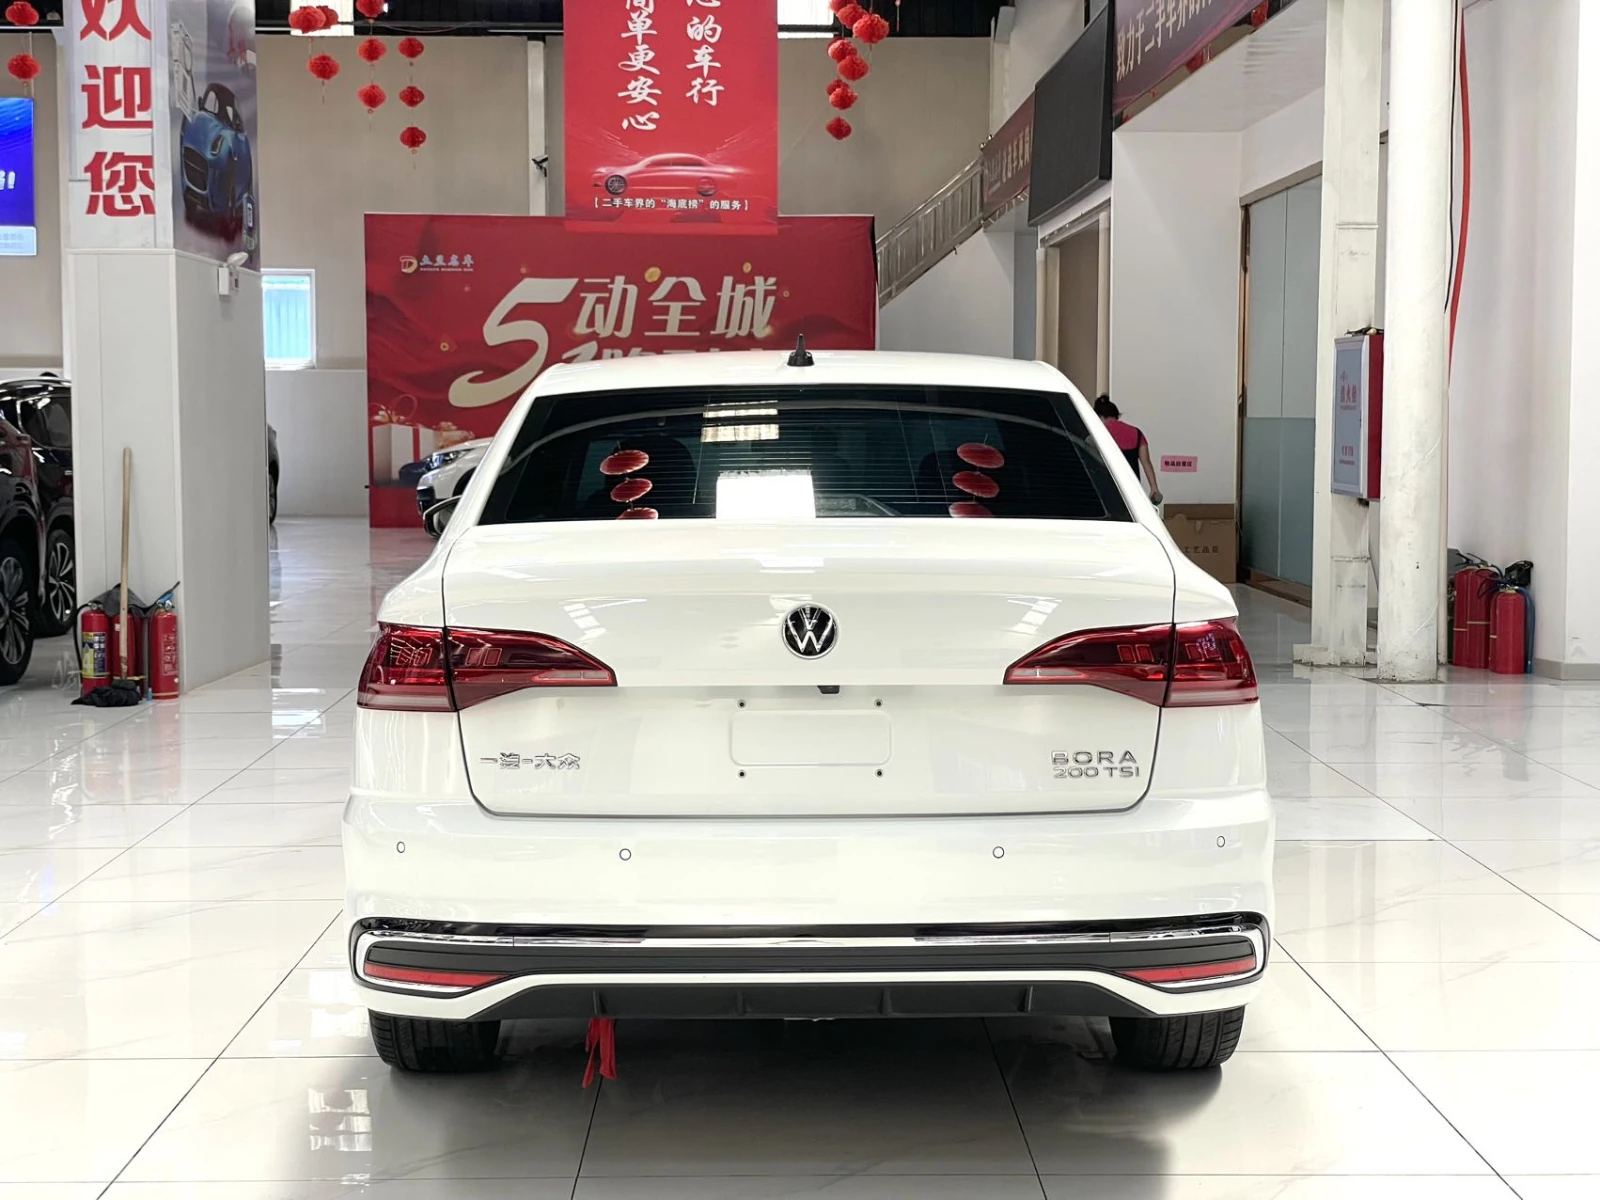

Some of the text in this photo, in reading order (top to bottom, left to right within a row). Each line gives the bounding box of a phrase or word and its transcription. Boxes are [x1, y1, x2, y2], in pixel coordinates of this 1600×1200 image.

[685, 0, 725, 106] 的车行
[1051, 750, 1138, 765] BORA
[1053, 766, 1140, 779] 200 TSI
